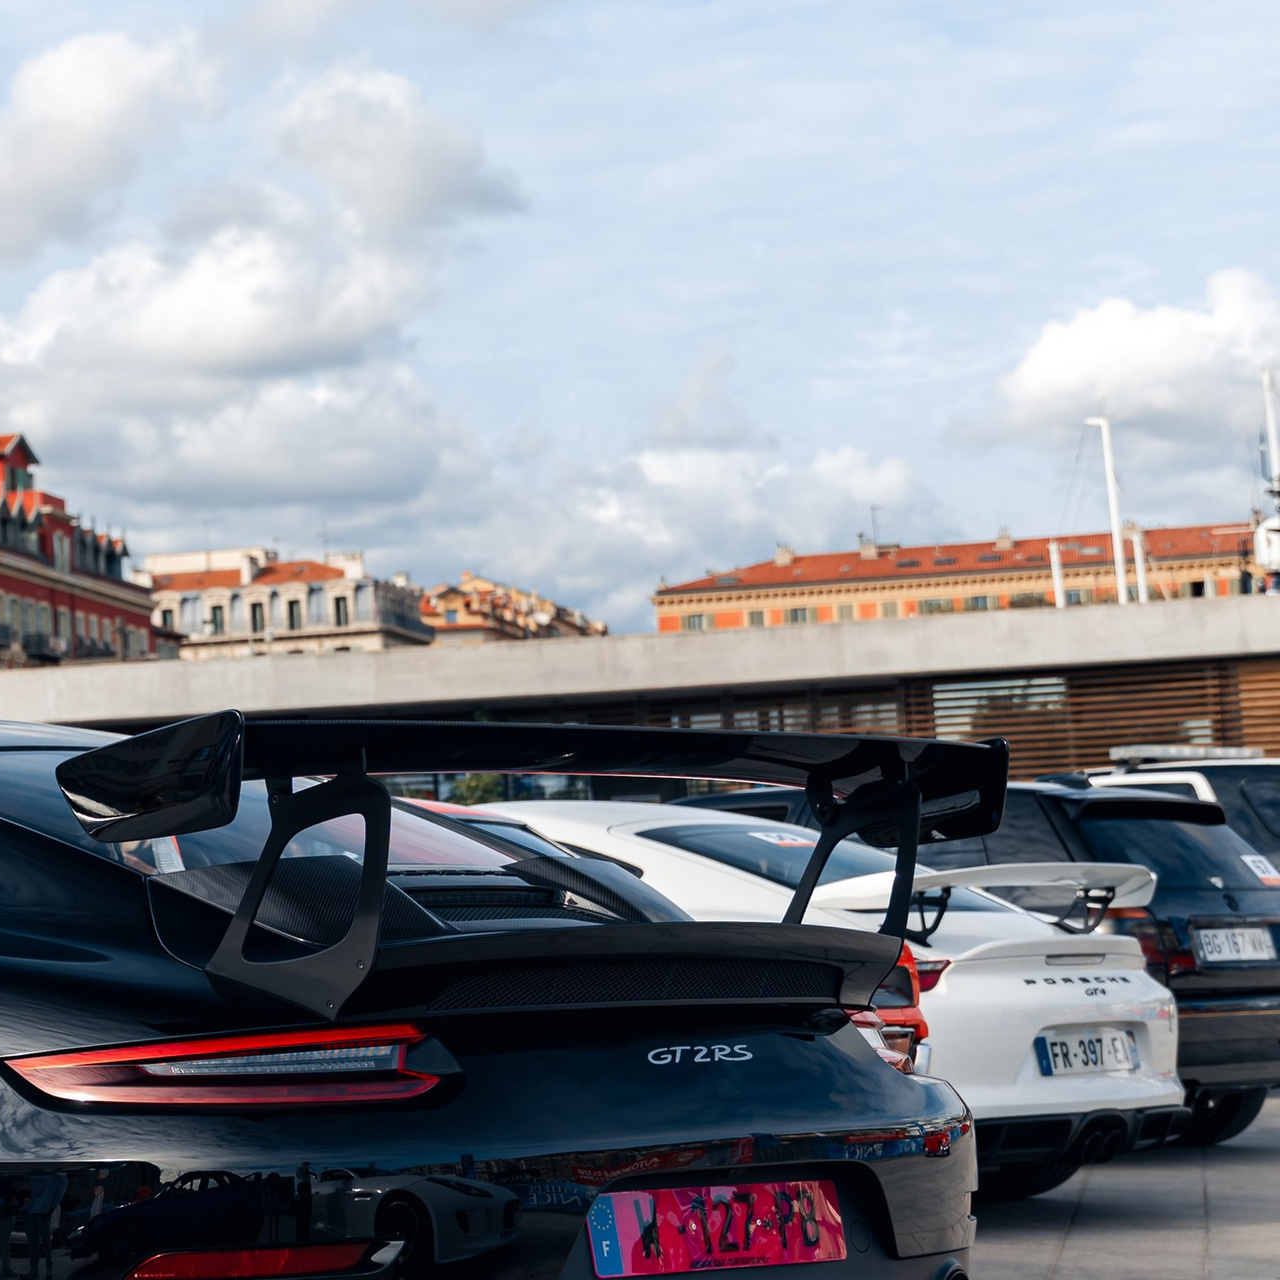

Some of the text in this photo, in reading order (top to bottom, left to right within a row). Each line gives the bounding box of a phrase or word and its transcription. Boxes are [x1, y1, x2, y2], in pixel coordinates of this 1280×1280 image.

[1023, 976, 1131, 986] PORSCHE
[1084, 987, 1107, 997] GT4
[602, 1240, 611, 1257] F
